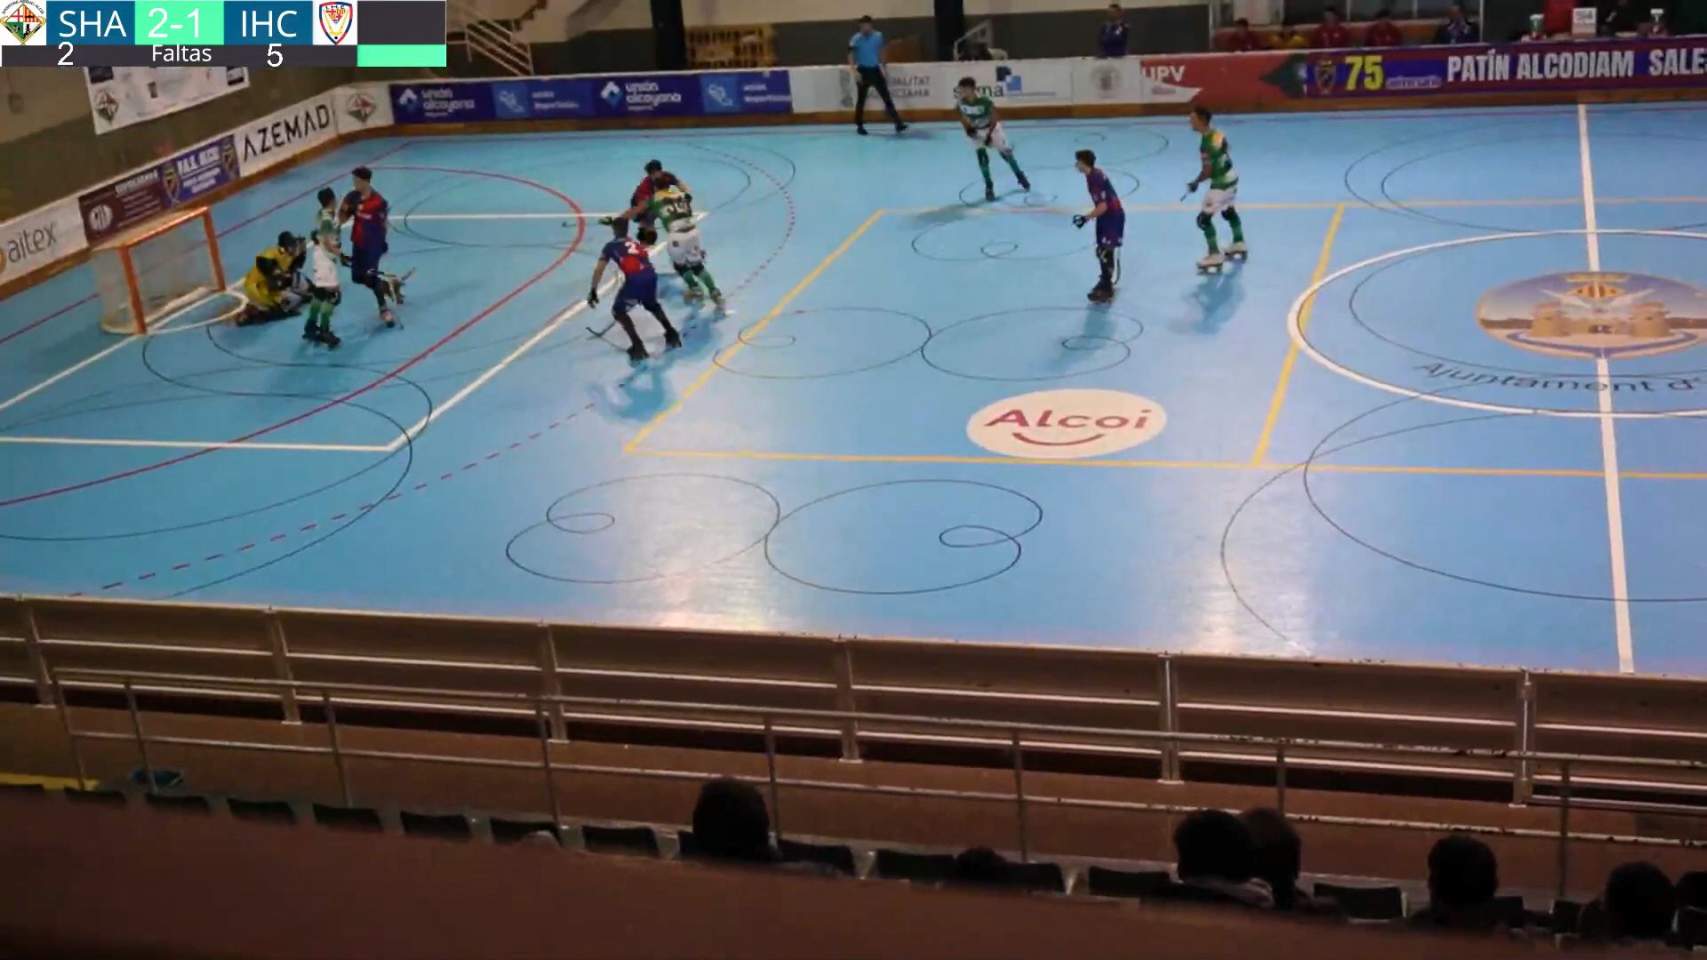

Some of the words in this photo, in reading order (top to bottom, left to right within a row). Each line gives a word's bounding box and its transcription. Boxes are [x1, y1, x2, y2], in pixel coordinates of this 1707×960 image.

[1142, 65, 1186, 83] UPV
[1344, 55, 1384, 91] 75
[1447, 48, 1510, 83] PATÍN
[1516, 51, 1635, 80] ALCODIAM
[1649, 48, 1707, 76] SALE
[953, 84, 1003, 99] sma
[242, 103, 331, 161] AZEMAD
[8, 222, 58, 265] aitex
[983, 408, 1152, 430] Alcoi
